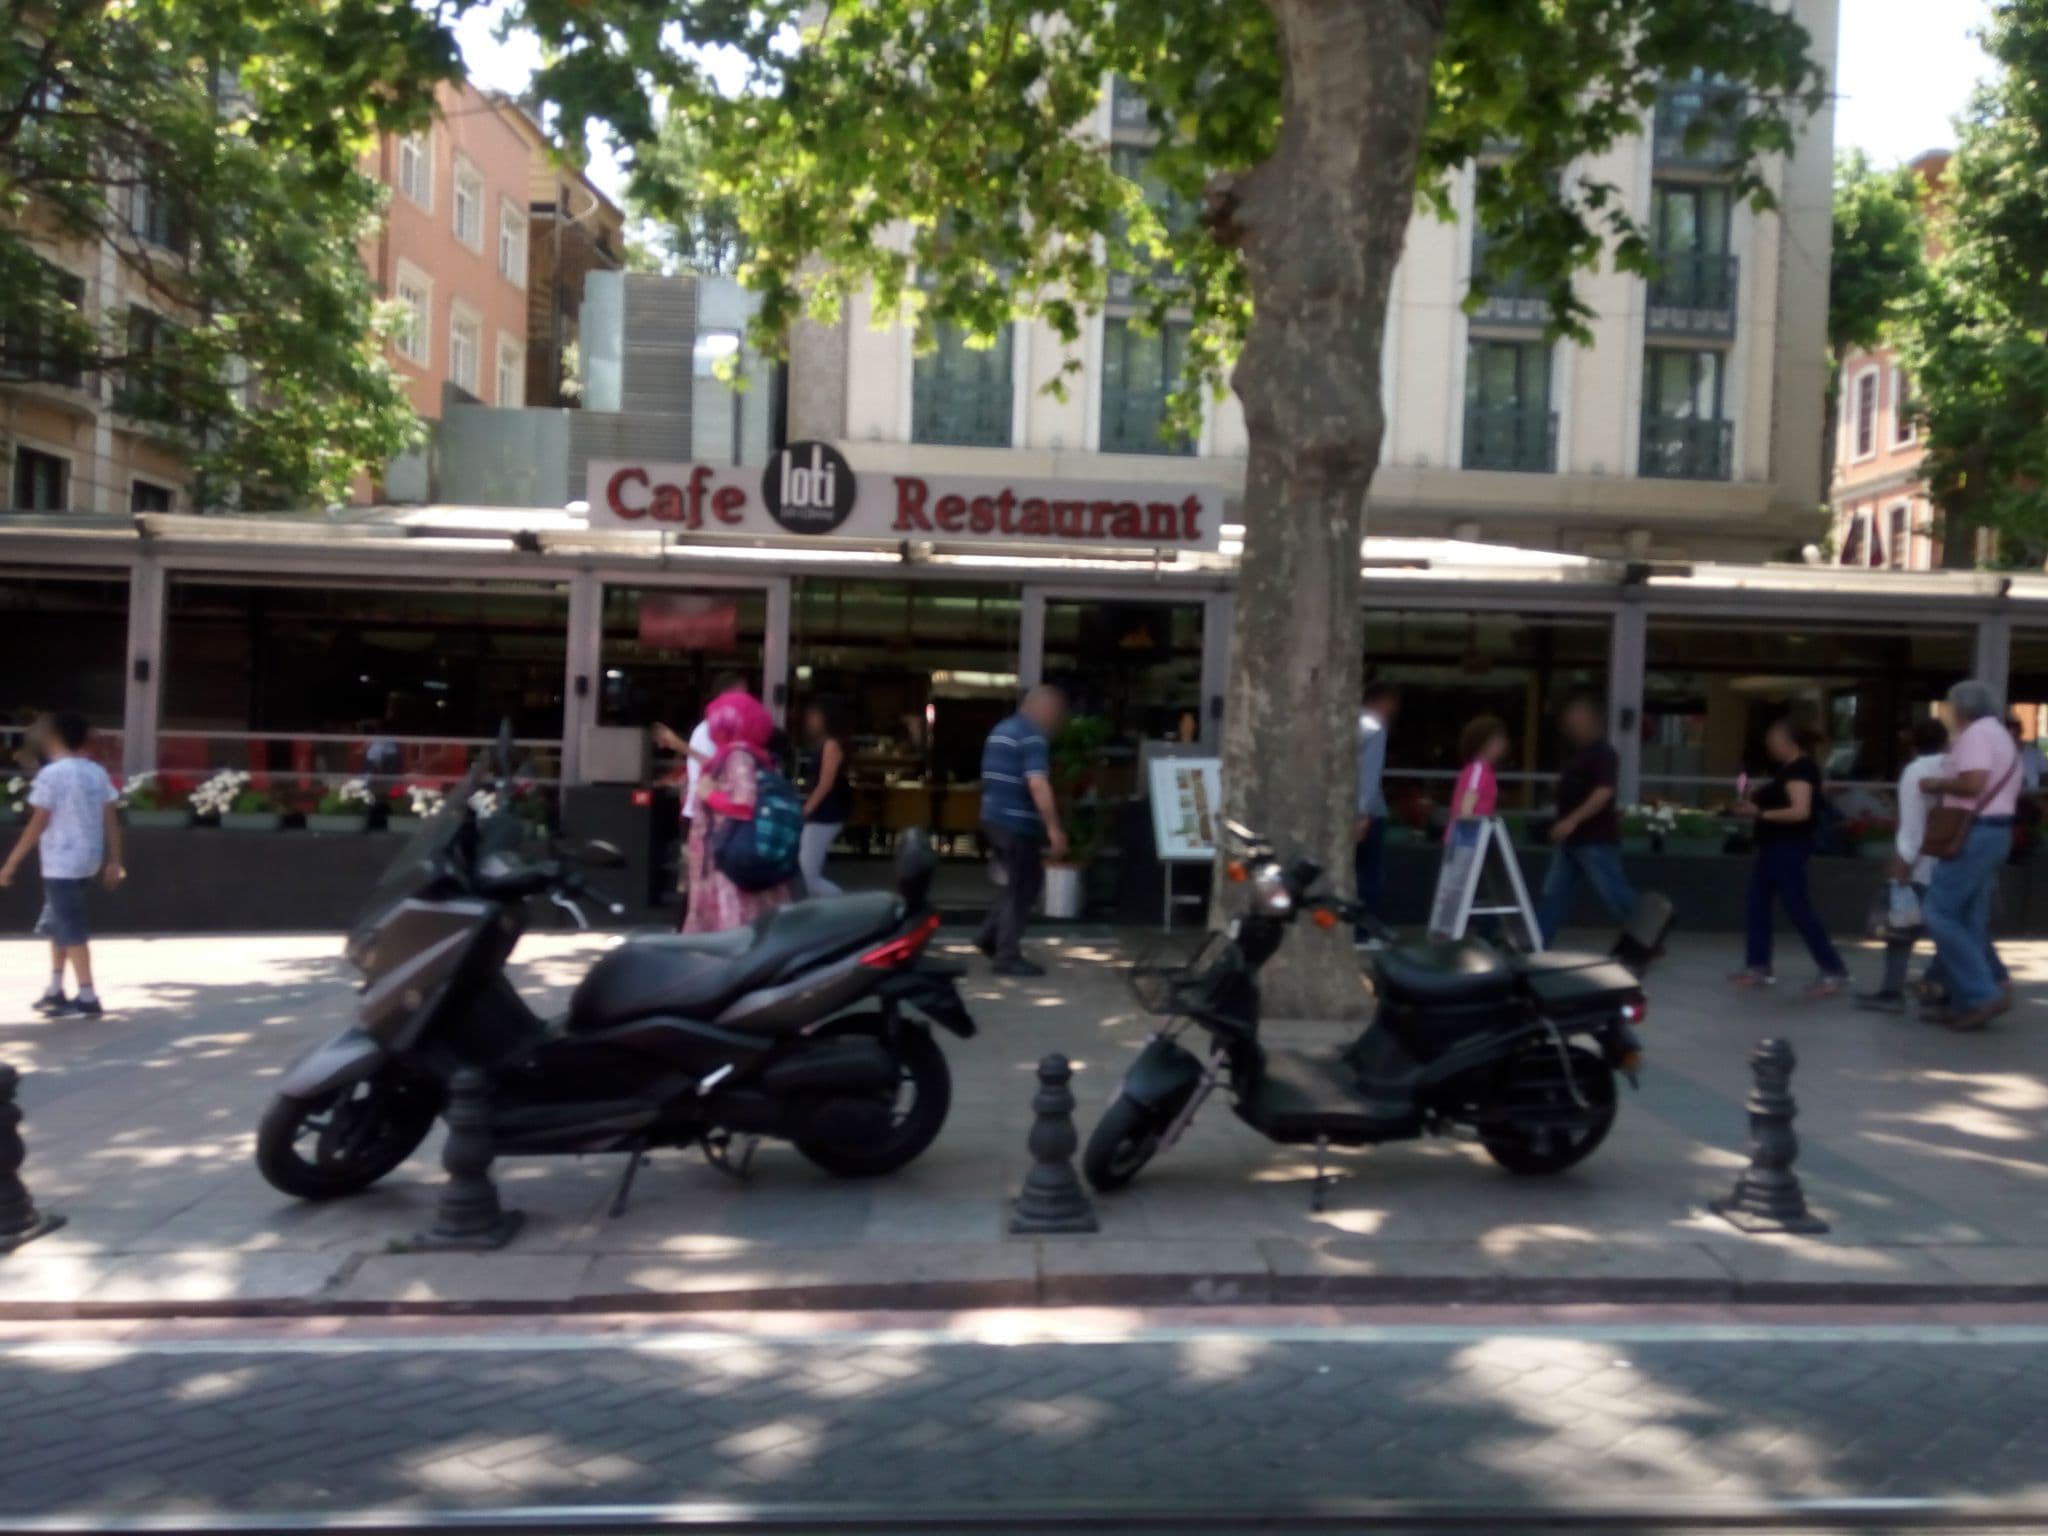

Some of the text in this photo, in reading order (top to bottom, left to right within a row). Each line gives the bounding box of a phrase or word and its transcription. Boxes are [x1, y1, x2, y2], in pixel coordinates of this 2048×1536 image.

[606, 444, 1203, 540] Cafe loti Restaurant
